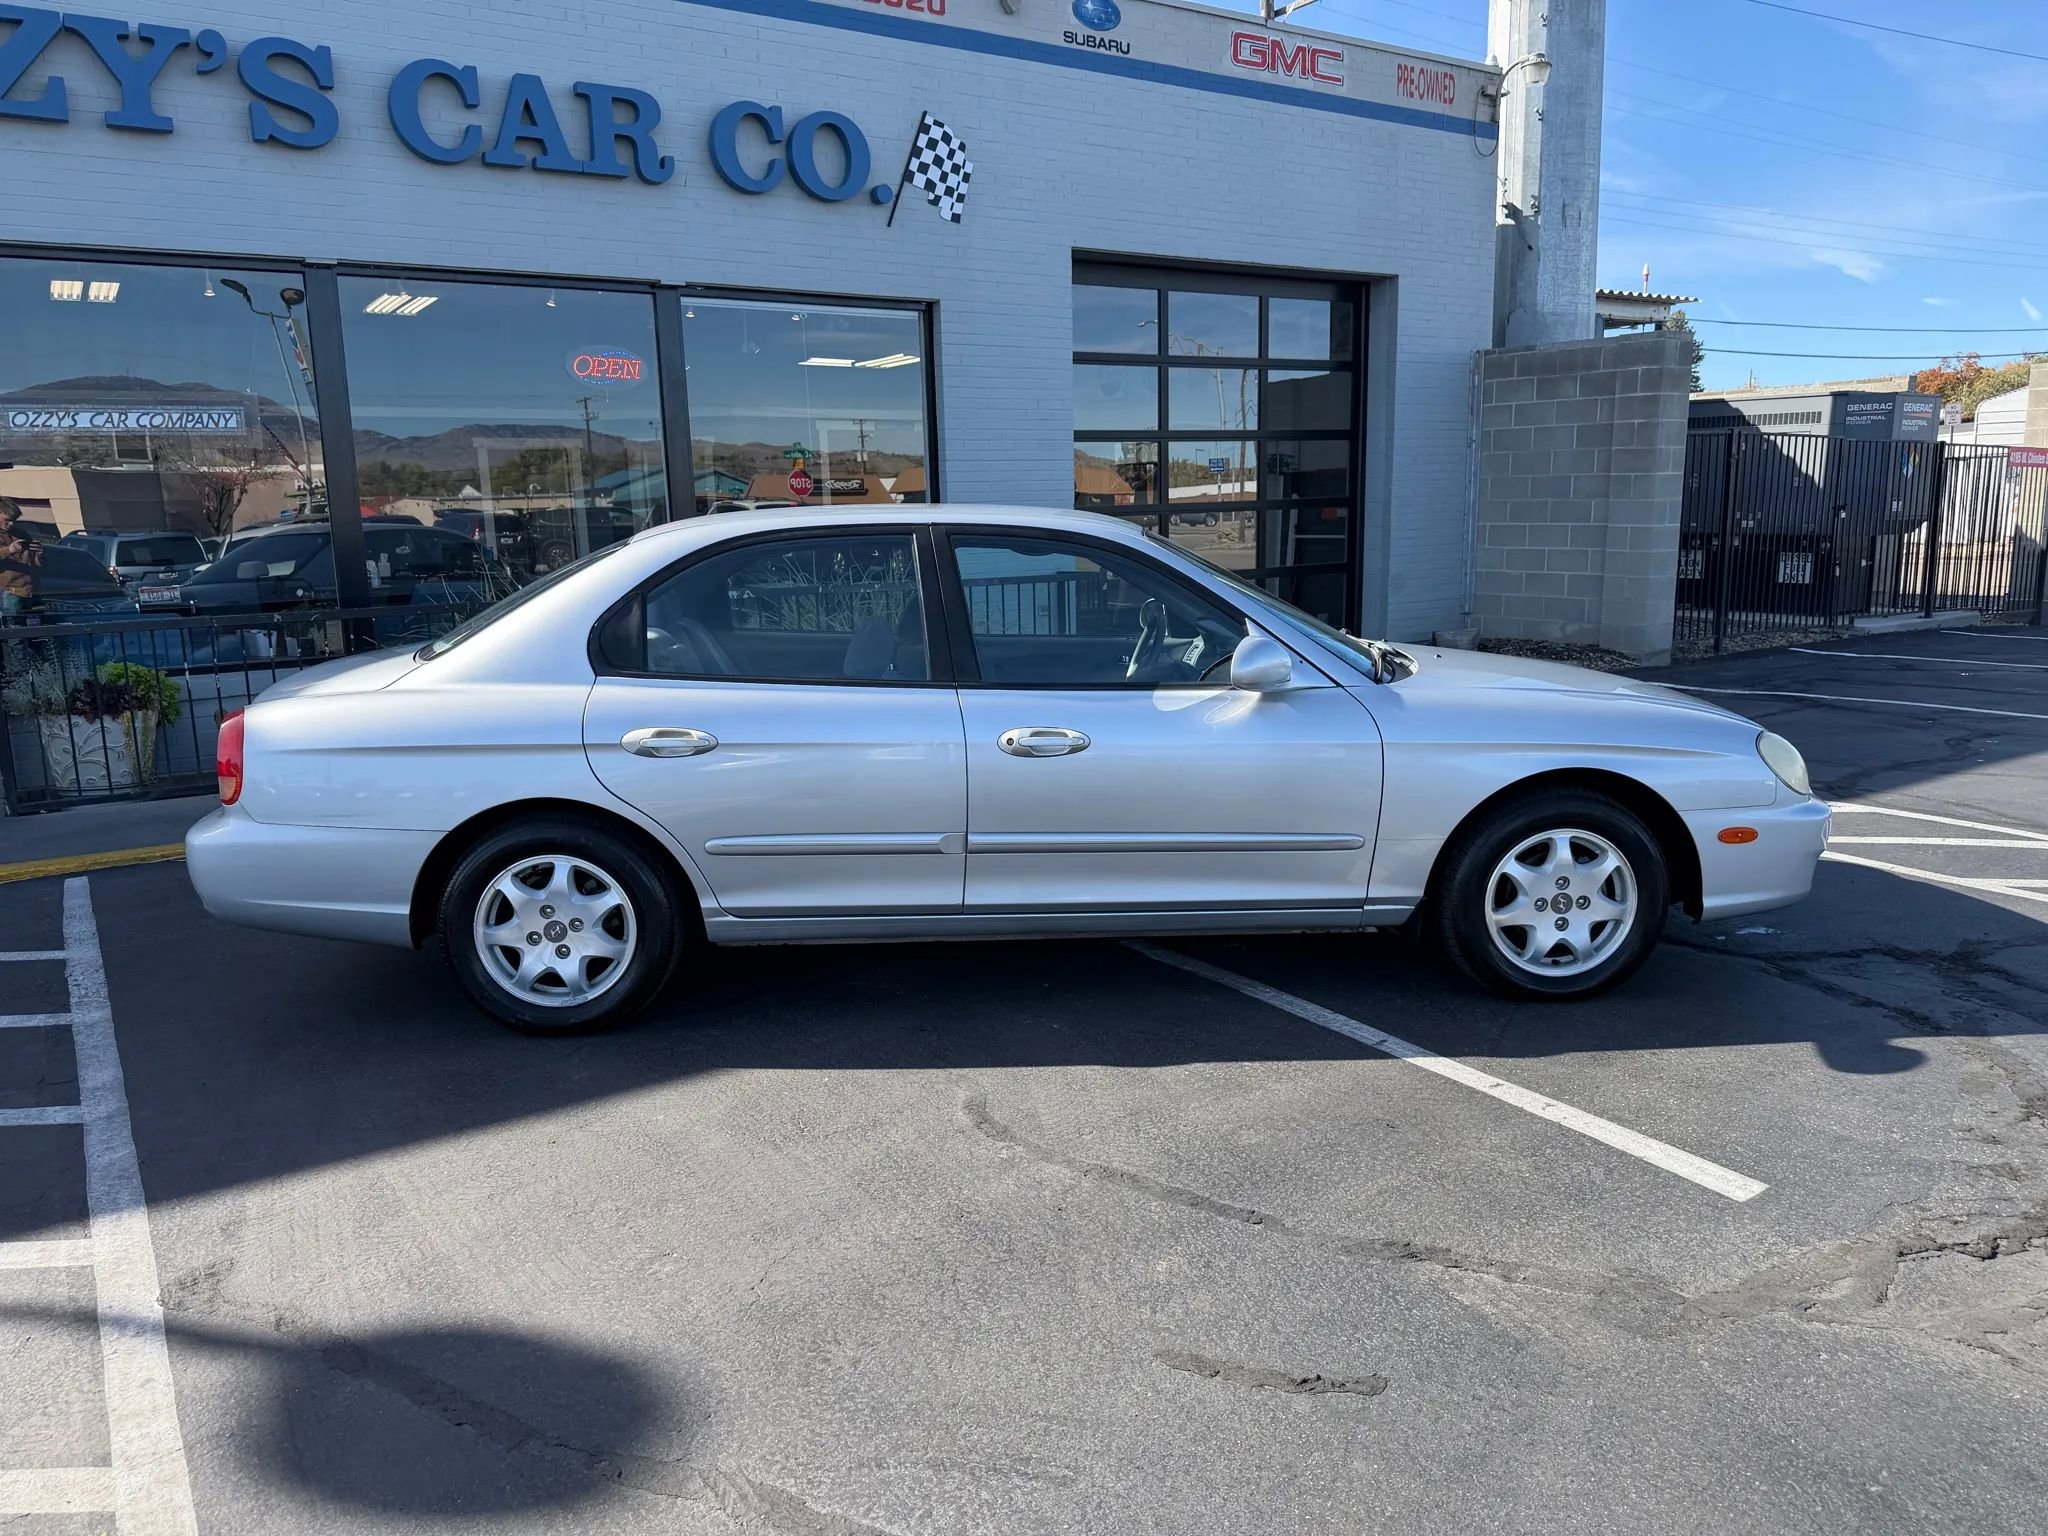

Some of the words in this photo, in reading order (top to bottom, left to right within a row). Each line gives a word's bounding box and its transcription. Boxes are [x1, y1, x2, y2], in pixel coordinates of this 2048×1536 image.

[1063, 30, 1130, 55] SUBARU
[1231, 31, 1344, 86] GMC
[1397, 63, 1456, 105] PRE-OWNED
[388, 58, 674, 185] CAR
[708, 100, 893, 205] CO.
[573, 355, 641, 380] OPEN
[1847, 402, 1893, 411] GENERAC
[1903, 402, 1933, 412] GENERAC
[11, 412, 79, 428] OZZY'S
[89, 412, 129, 428] CAR
[135, 412, 234, 428] COMPANY
